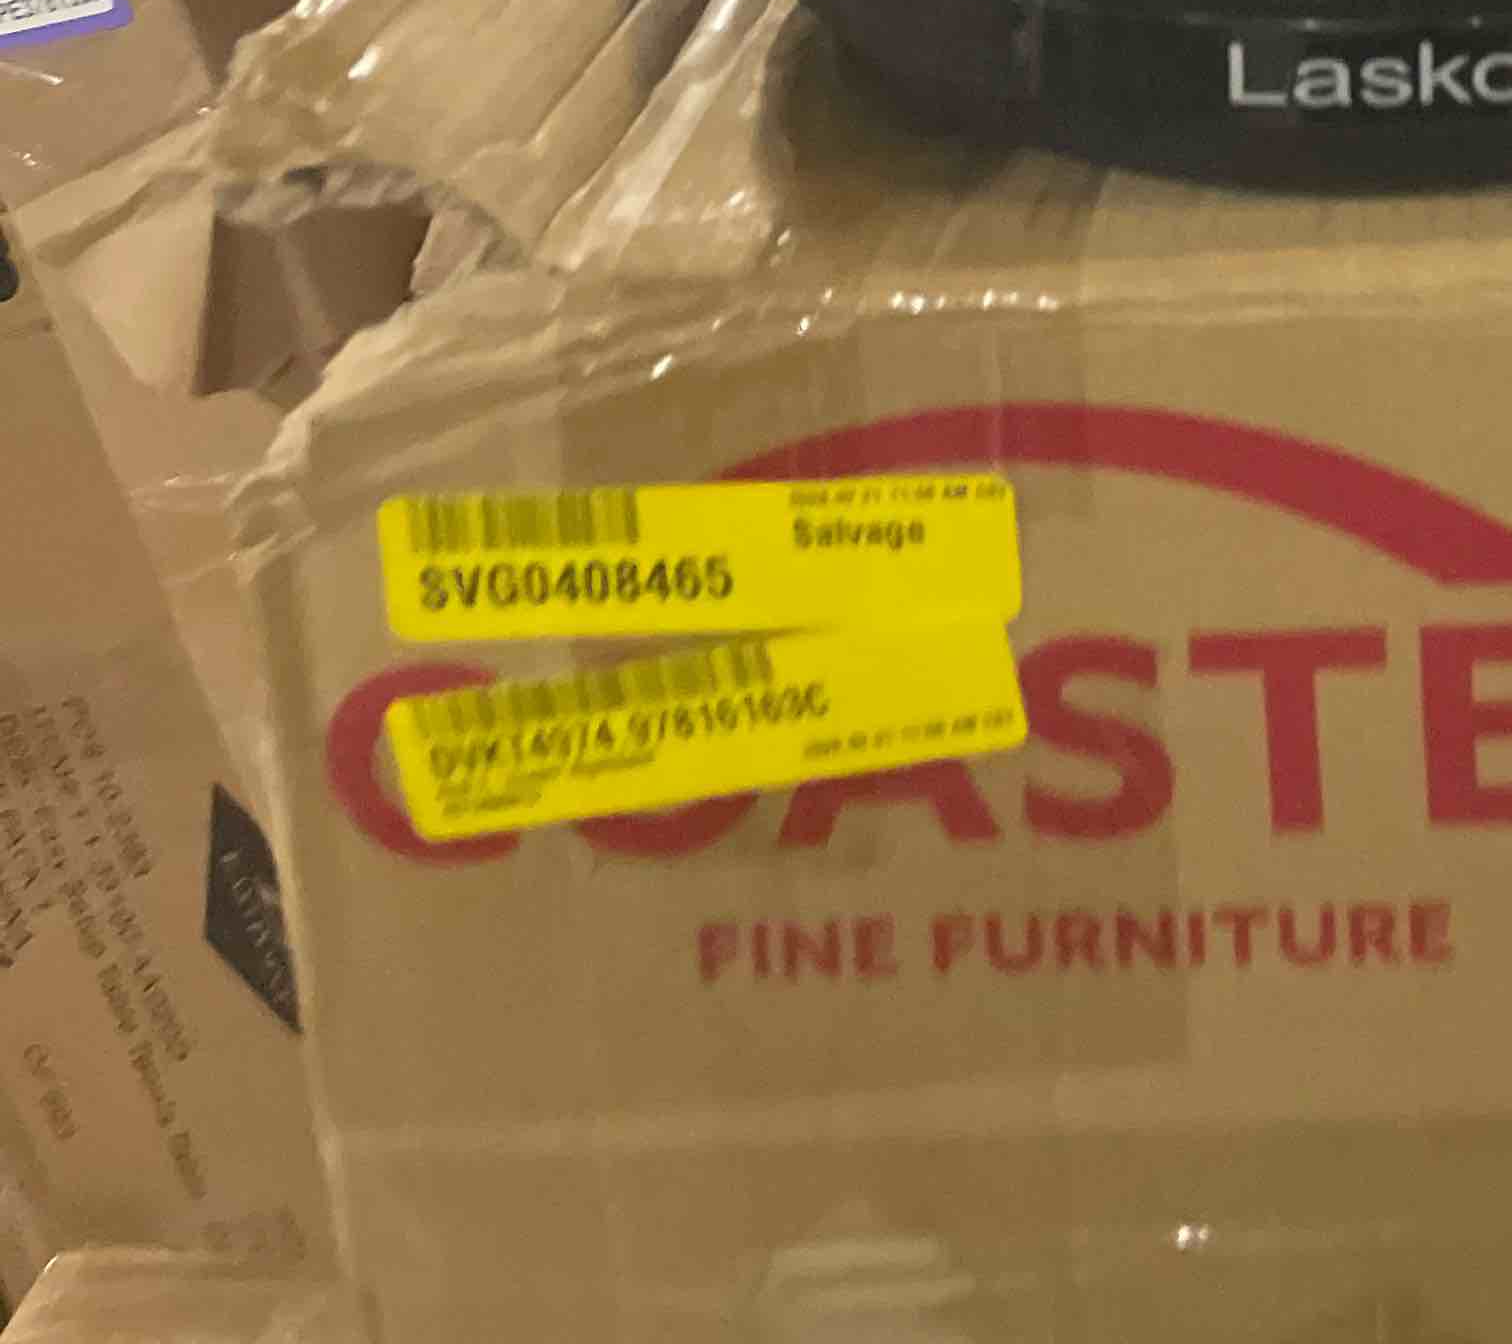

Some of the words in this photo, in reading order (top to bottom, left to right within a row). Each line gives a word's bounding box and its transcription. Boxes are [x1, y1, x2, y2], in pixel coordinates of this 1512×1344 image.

[793, 517, 926, 551] Salvage
[419, 557, 734, 612] SVG0408465
[696, 913, 898, 986] FINE
[926, 898, 1455, 978] FURNITURE
